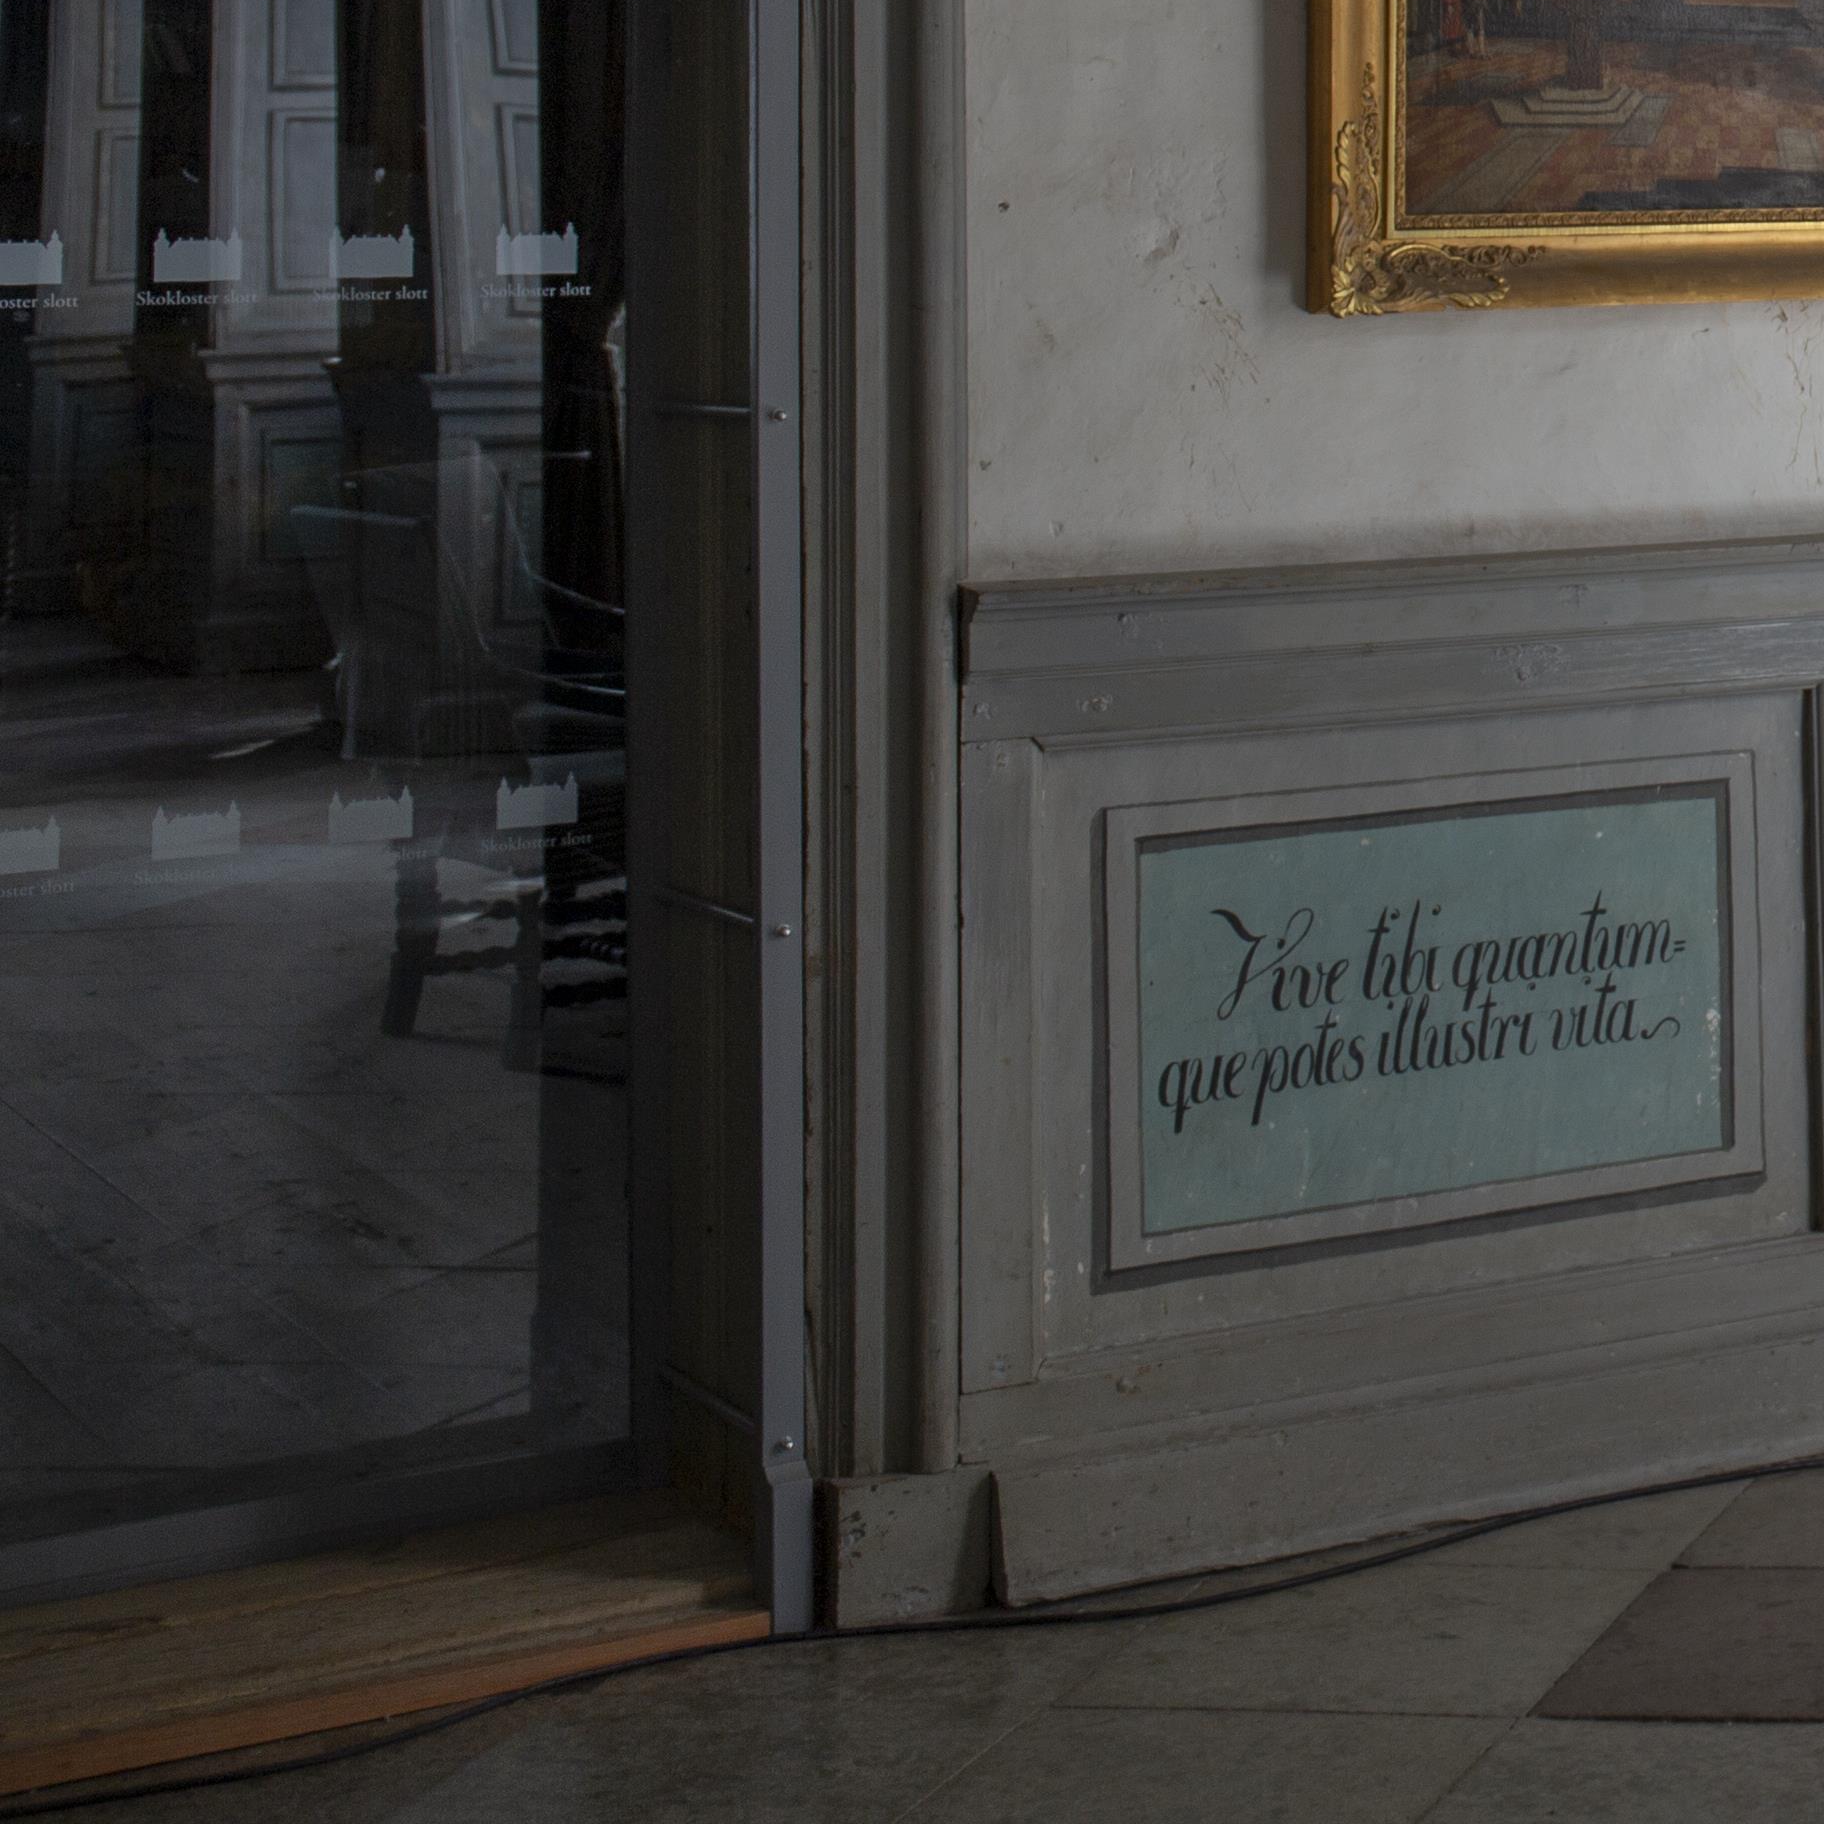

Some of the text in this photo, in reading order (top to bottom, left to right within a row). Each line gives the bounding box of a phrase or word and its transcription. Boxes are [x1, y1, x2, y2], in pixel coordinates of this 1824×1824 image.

[136, 290, 219, 307] Skokloster
[395, 285, 429, 301] slott
[479, 281, 592, 300] Skokloster slott
[42, 292, 79, 309] slott
[560, 831, 593, 846] slott
[1210, 907, 1350, 1021] Vive
[1362, 898, 1445, 1001] tibi
[1158, 1051, 1247, 1135] que
[1250, 1009, 1366, 1127] potes
